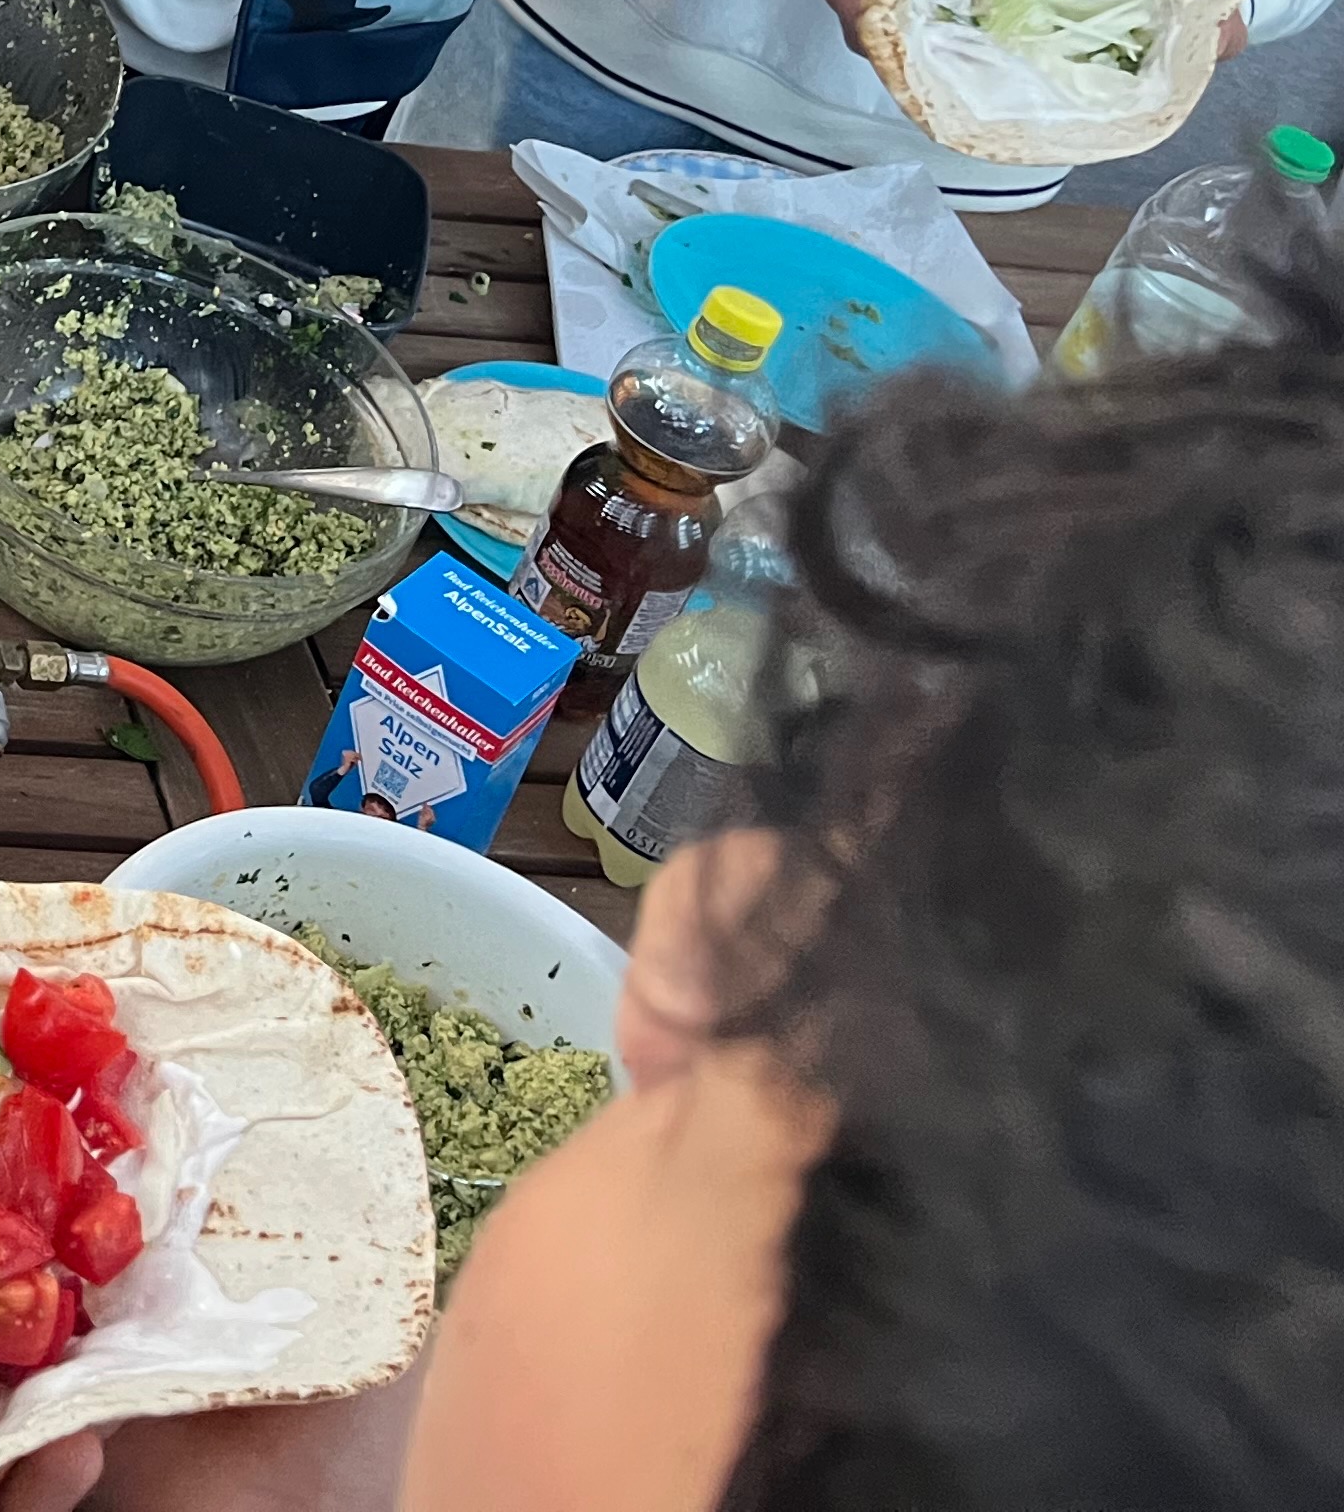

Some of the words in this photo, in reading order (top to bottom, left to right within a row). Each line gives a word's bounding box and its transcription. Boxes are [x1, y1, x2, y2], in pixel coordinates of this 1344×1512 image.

[443, 590, 531, 654] AlpenSalz
[470, 589, 559, 650] Reichenhaller
[362, 653, 394, 681] Bad
[391, 676, 495, 751] Reichenhaller
[378, 737, 423, 779] Salz
[379, 715, 440, 766] Alpen
